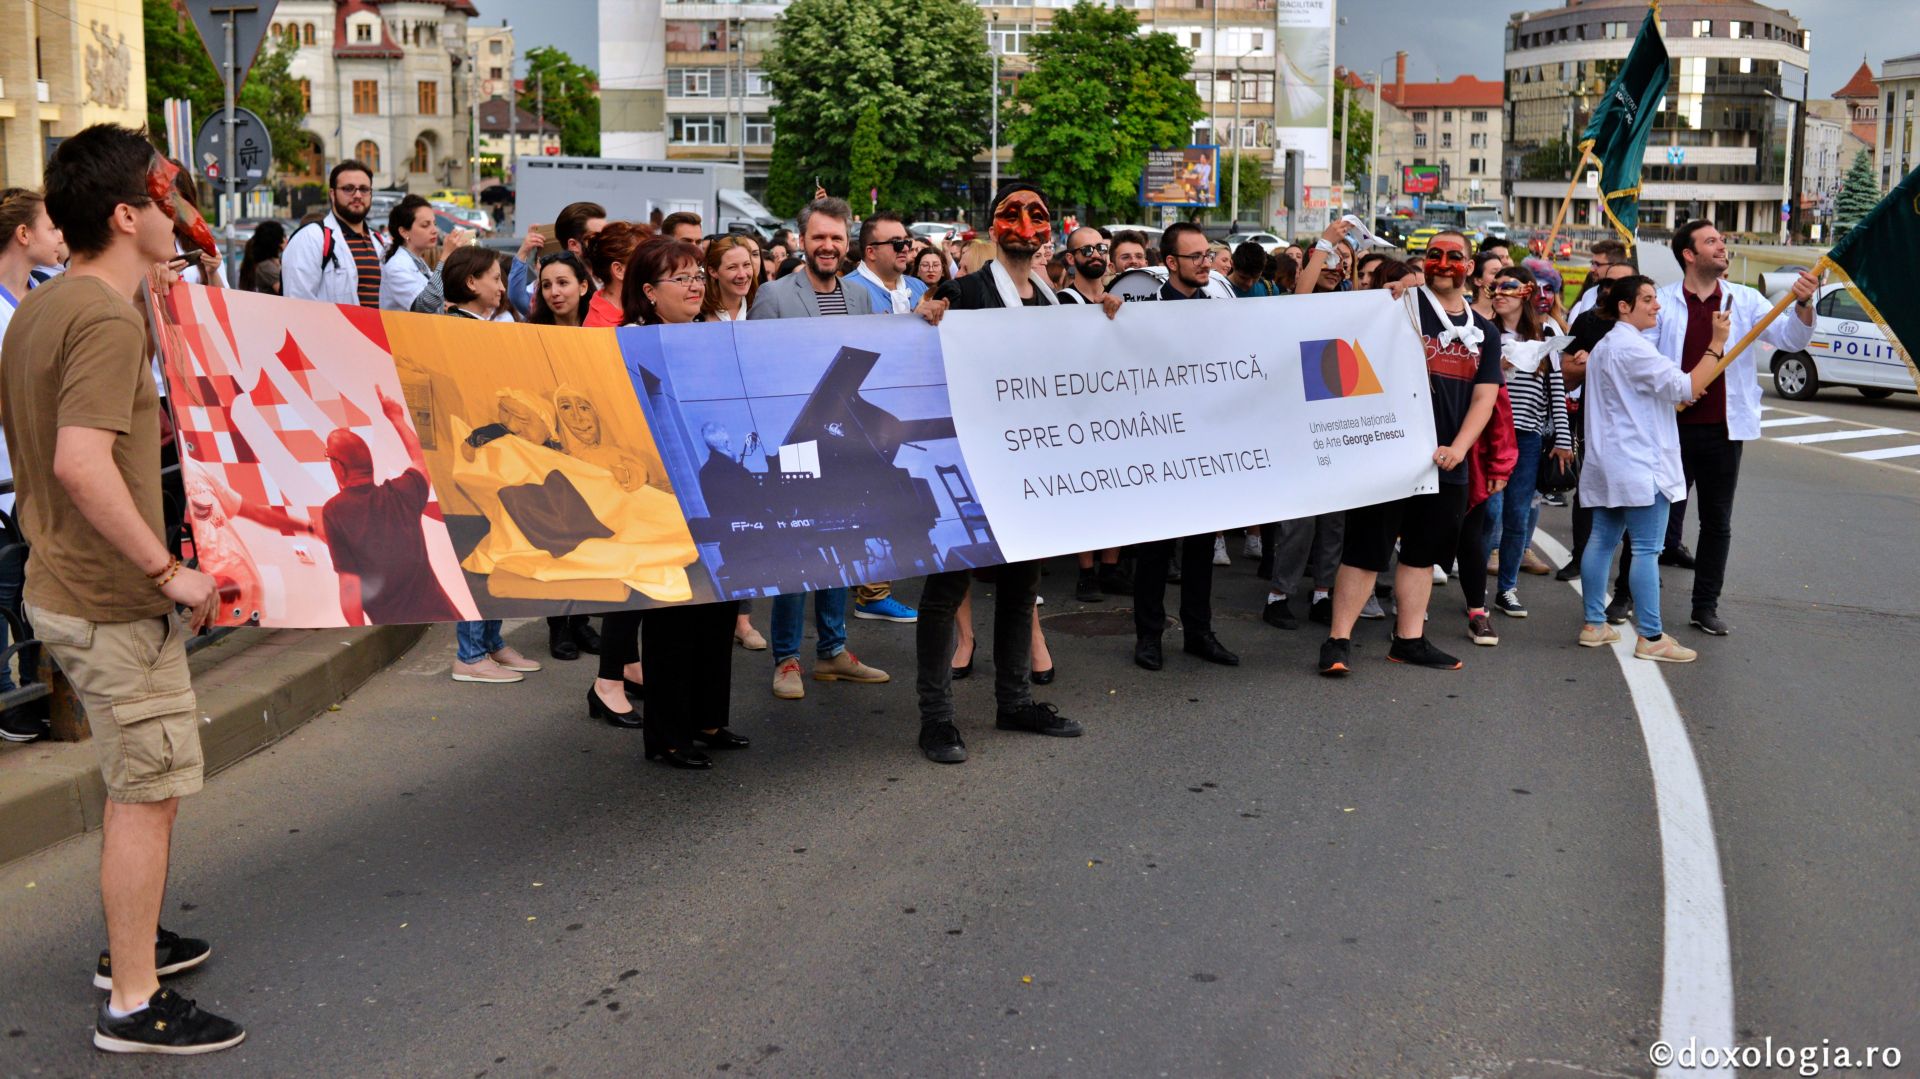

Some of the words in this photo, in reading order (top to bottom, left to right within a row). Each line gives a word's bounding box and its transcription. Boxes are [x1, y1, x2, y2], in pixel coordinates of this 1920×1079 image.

[1833, 340, 1894, 359] POLIT
[996, 376, 1047, 401] PRIN
[1055, 368, 1160, 395] EDUCAȚIA
[1164, 354, 1268, 388] ARTISTICĂ,
[1004, 425, 1063, 451] SPRE
[1068, 423, 1084, 445] O
[1090, 411, 1186, 442] ROMÂNIE
[1309, 418, 1360, 434] Universitatea
[1360, 412, 1397, 428] Națională
[1313, 438, 1325, 450] de
[1326, 436, 1342, 448] Arte
[1342, 433, 1374, 446] George
[1374, 429, 1405, 441] Enescu
[1316, 454, 1332, 467] Iași
[1024, 478, 1039, 500] A
[1039, 463, 1158, 497] VALORILOR
[1163, 448, 1272, 482] AUTENTICE!
